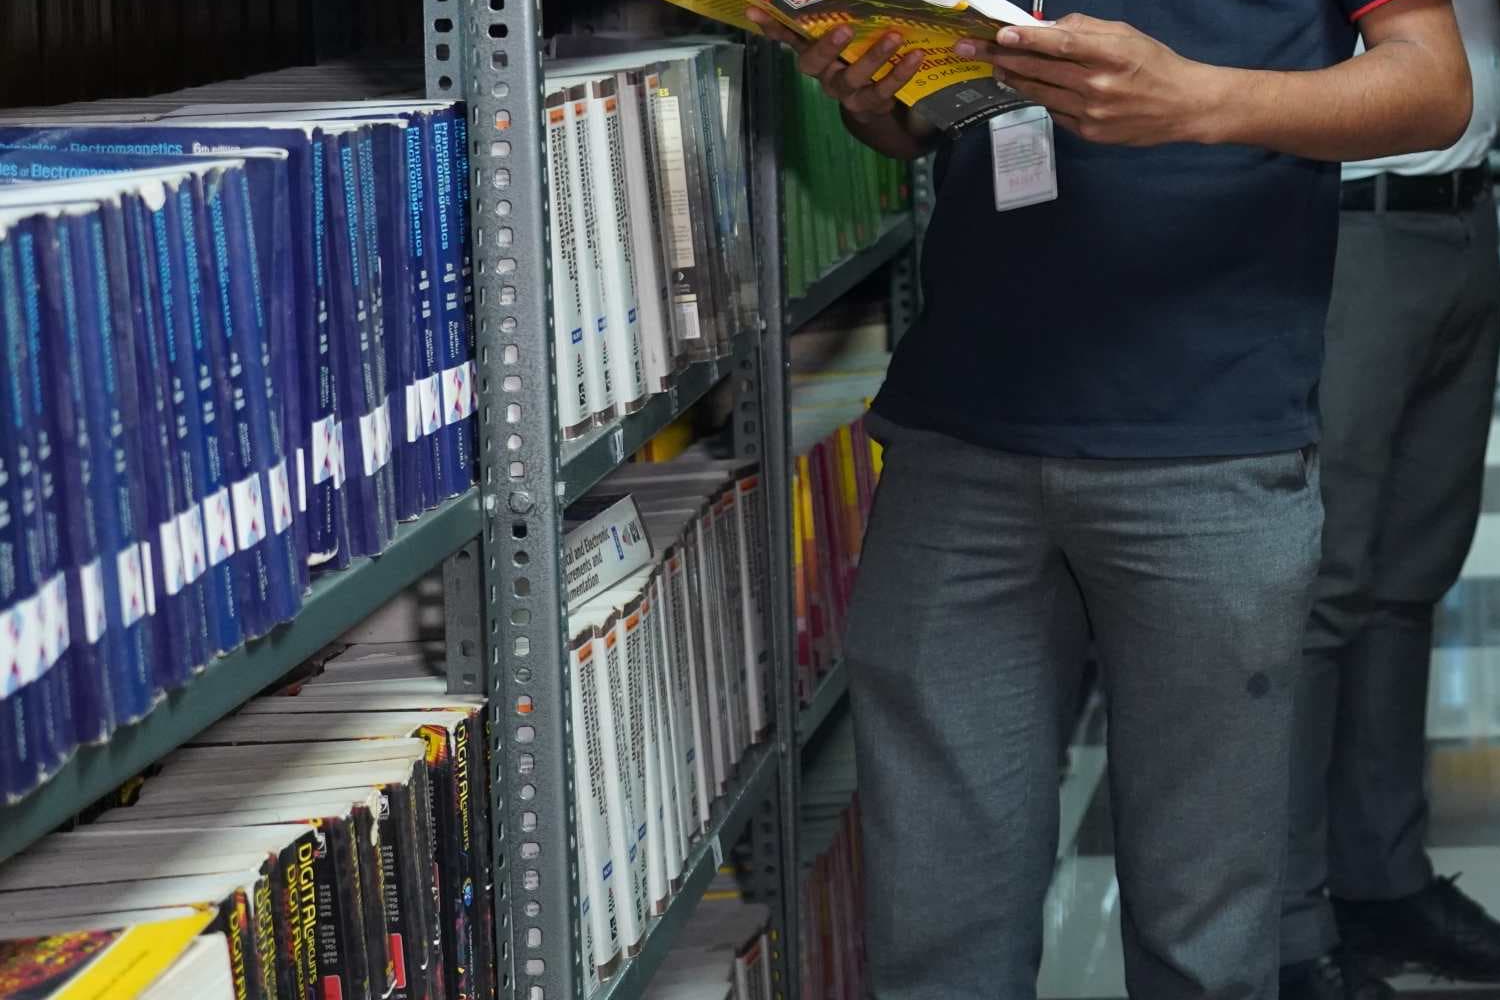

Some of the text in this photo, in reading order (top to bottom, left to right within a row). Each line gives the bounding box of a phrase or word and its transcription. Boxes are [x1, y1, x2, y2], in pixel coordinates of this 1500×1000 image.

[551, 127, 567, 260] Instrumentation
[455, 724, 469, 811] DIGITAL
[298, 842, 317, 938] DIGITAL
